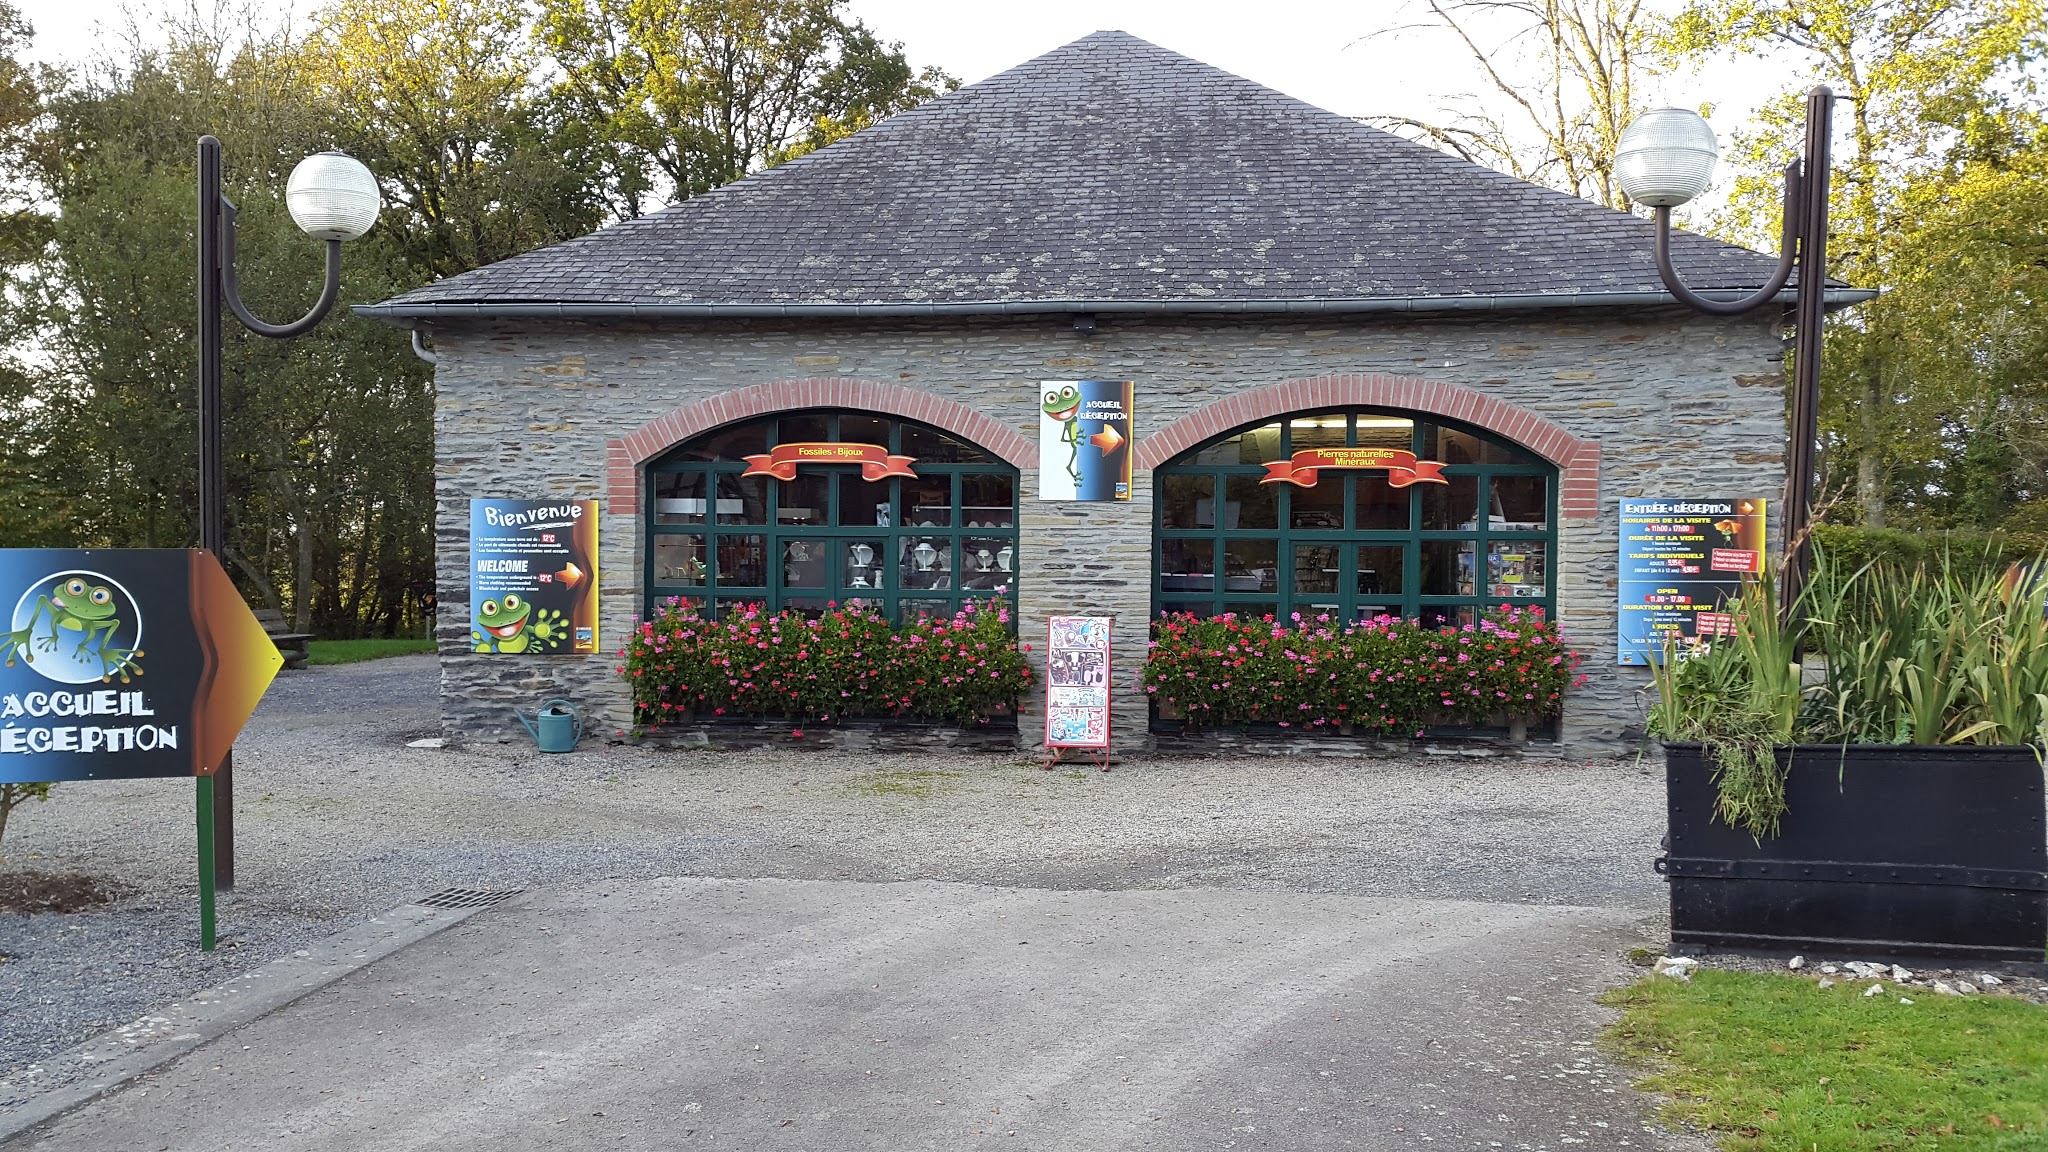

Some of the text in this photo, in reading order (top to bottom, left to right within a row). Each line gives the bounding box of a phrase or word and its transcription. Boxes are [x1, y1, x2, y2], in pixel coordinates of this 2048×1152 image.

[1080, 411, 1127, 420] RÉCEPTION
[798, 448, 863, 457] Fossiles Bijoux
[1317, 450, 1394, 458] Pierres naturelles
[1335, 458, 1376, 466] Minéraux
[485, 504, 582, 526] Bienvenue
[477, 560, 528, 572] WELCOME
[1, 690, 154, 718] ACCUEIL
[0, 722, 178, 754] ÉCEPTION
